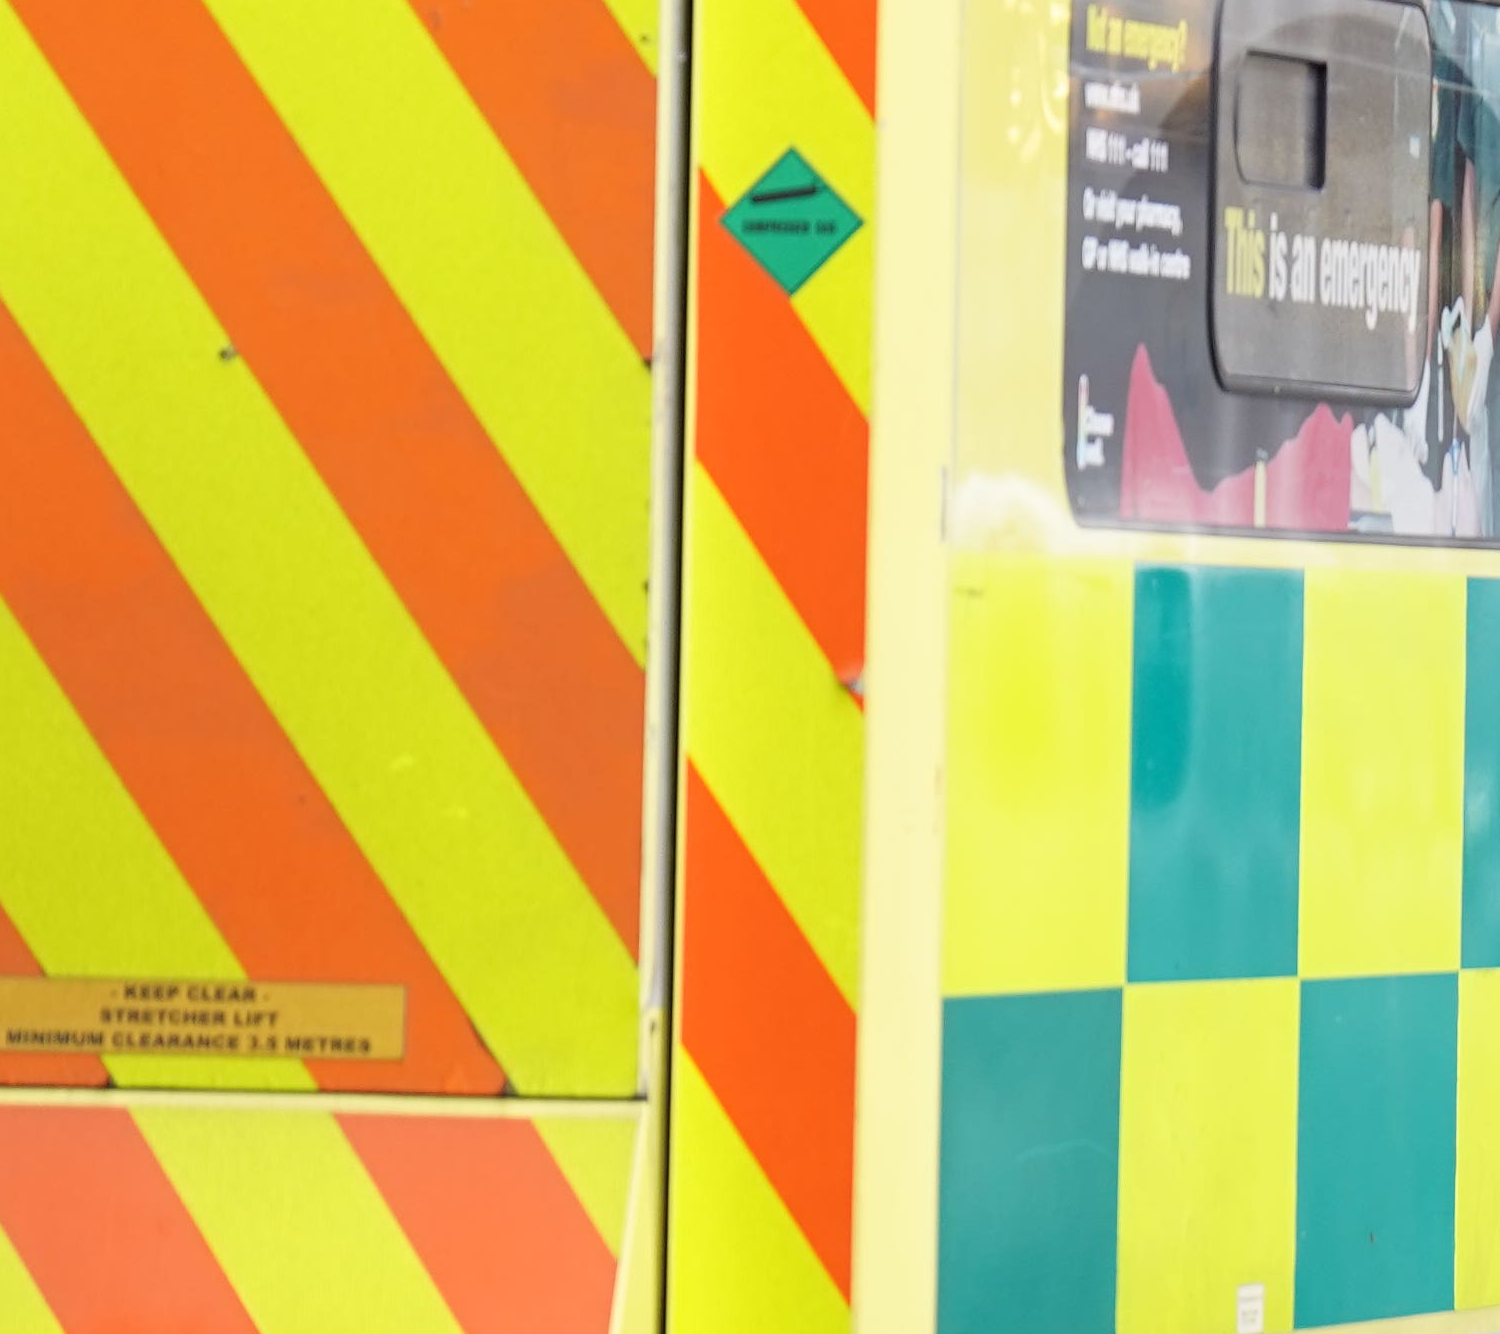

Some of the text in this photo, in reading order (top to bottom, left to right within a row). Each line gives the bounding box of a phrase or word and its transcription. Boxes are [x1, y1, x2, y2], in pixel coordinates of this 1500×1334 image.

[1225, 206, 1422, 334] This is an emergency
[123, 986, 257, 1003] KEEP CLEAR
[100, 1009, 280, 1028] STRETCHER LIFT
[5, 1029, 104, 1047] MINIMUM
[111, 1033, 241, 1051] CLEARANCE
[284, 1037, 372, 1055] METRES
